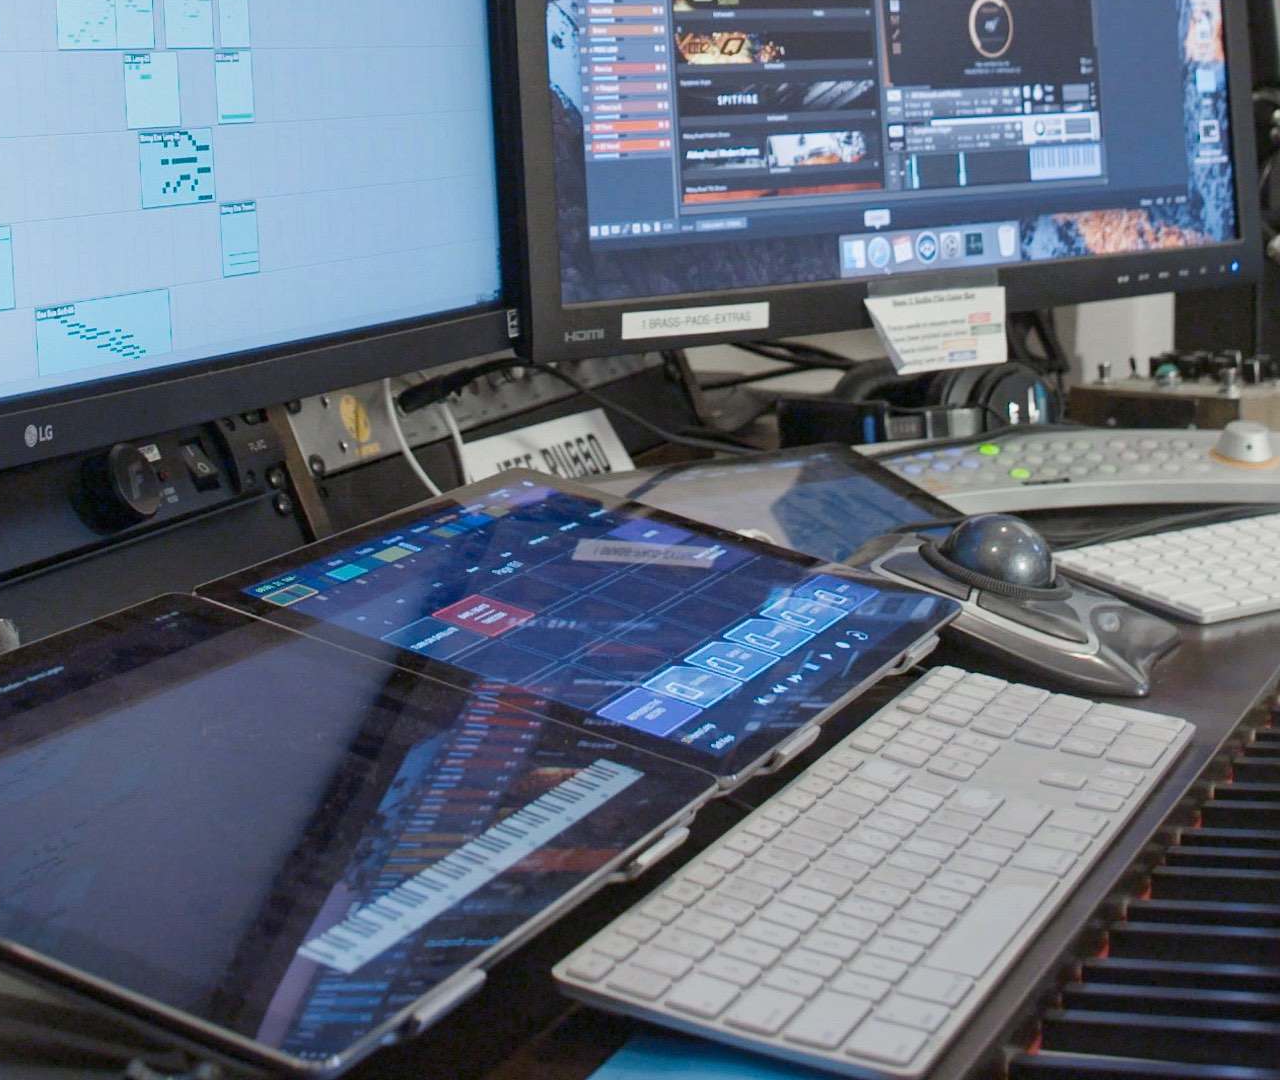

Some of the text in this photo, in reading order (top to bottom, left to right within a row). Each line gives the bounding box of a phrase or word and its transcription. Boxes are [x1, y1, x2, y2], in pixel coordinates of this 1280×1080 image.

[717, 94, 758, 106] SPITFIRE
[564, 328, 604, 343] HDMI
[39, 425, 53, 441] LG
